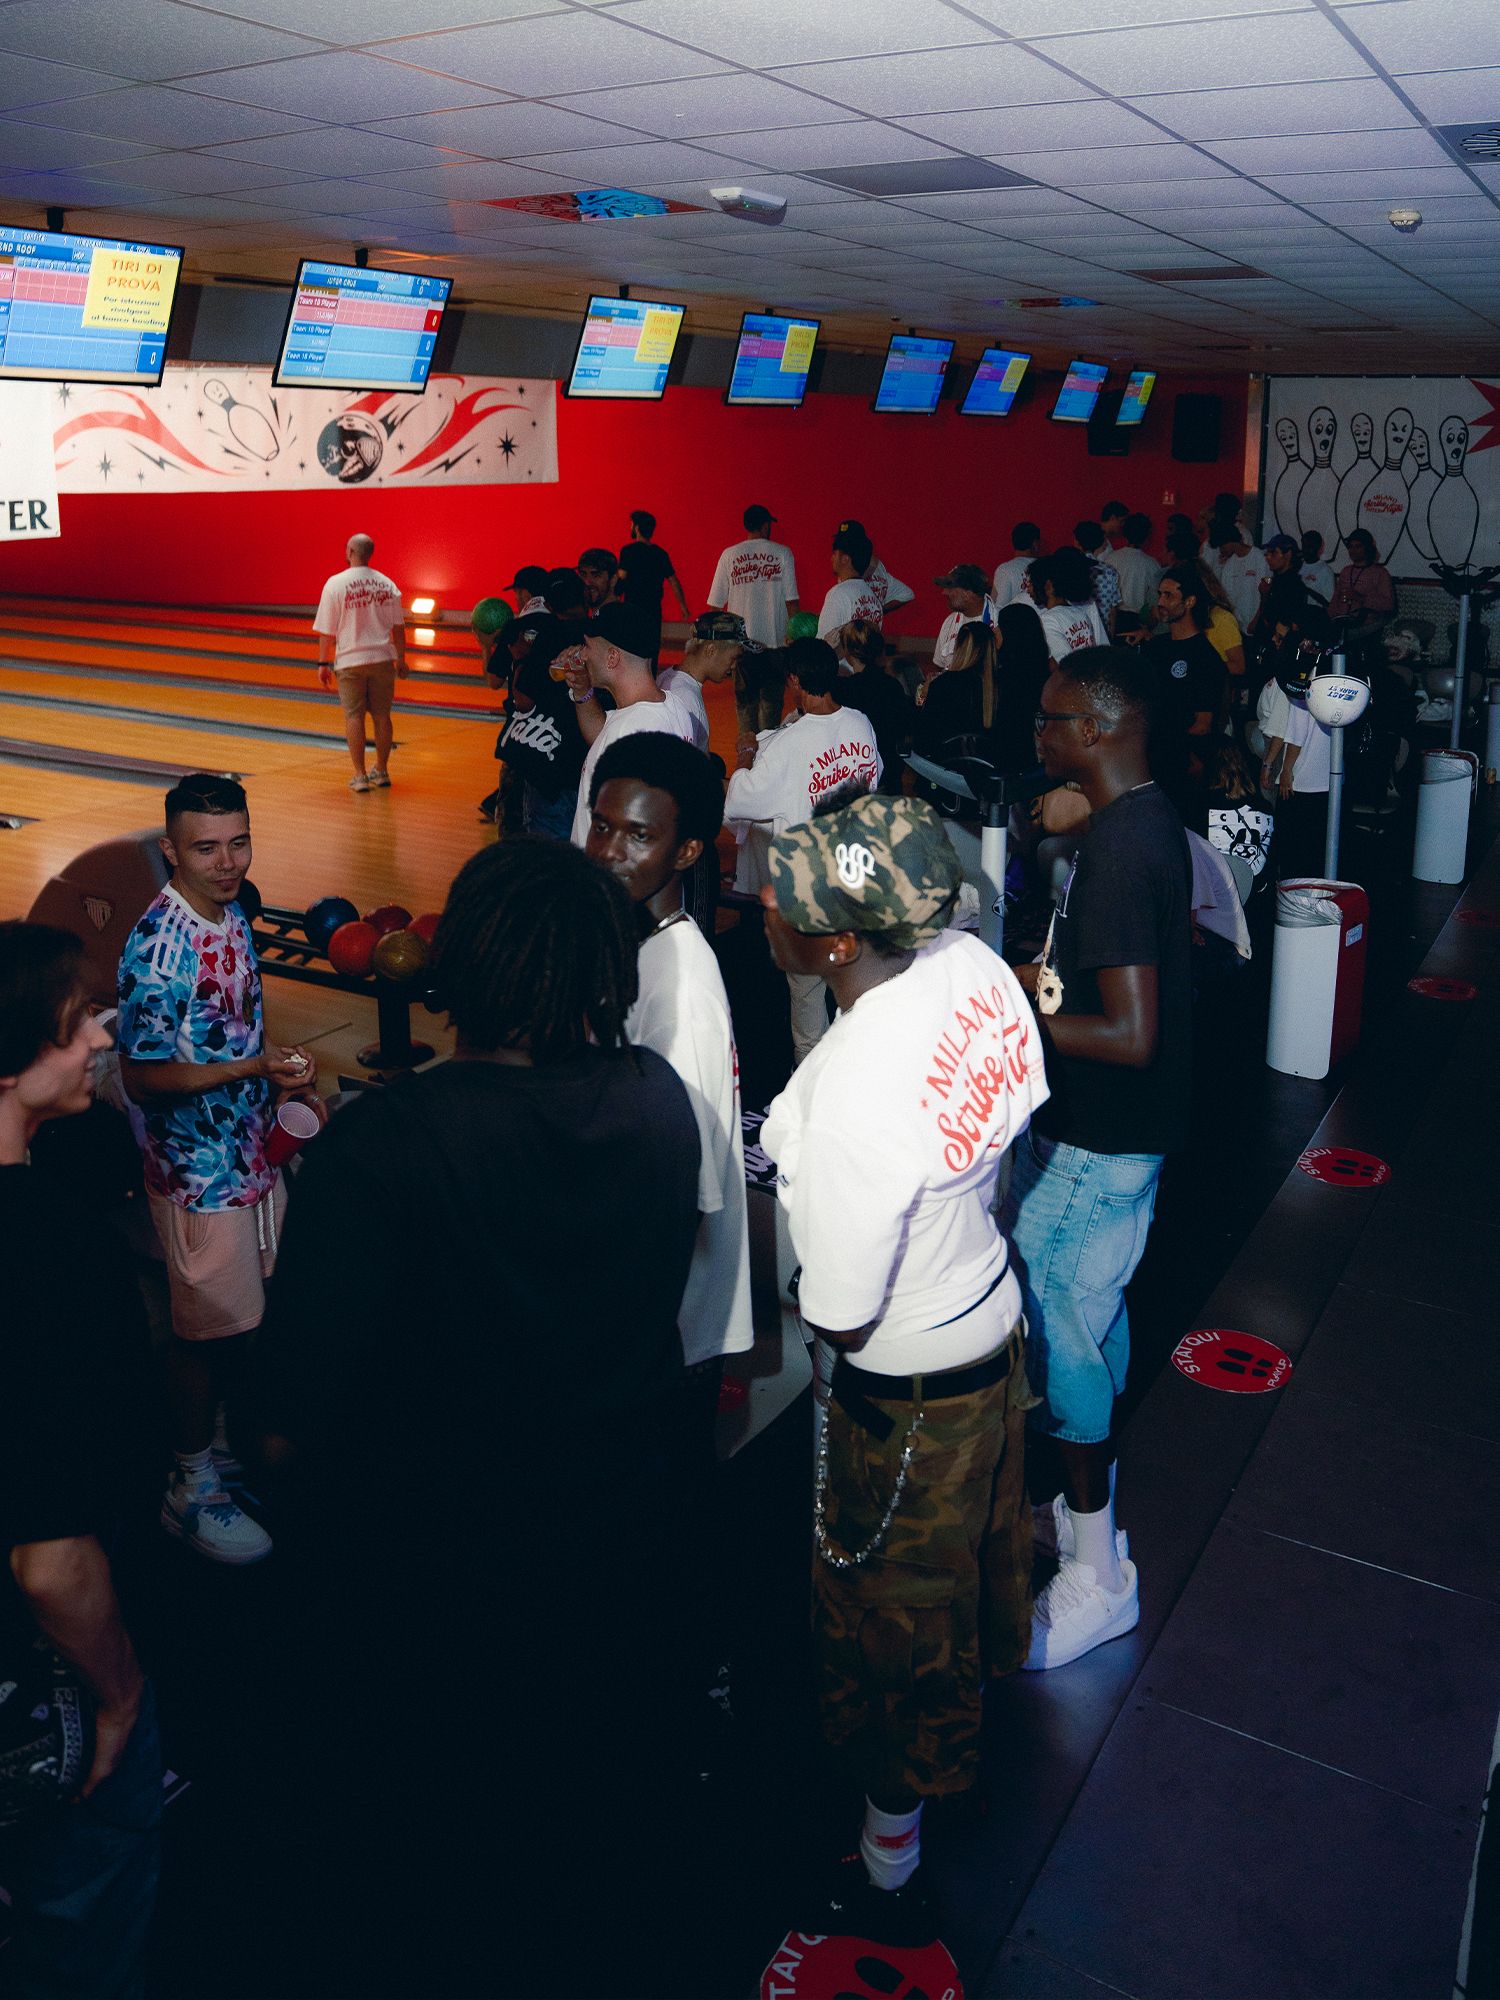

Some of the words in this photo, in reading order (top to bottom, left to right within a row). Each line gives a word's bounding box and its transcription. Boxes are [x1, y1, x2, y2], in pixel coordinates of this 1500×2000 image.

[112, 258, 140, 272] TIRI
[145, 262, 162, 275] DI
[107, 276, 160, 291] PROVA
[735, 552, 774, 564] MILANO
[731, 562, 758, 578] Strike
[754, 562, 782, 580] Night
[349, 579, 385, 589] MILANO
[816, 741, 870, 770] MILANO
[808, 762, 851, 795] Strike
[926, 985, 1005, 1100] MILANO
[938, 1056, 1005, 1173] Strike
[1297, 1154, 1320, 1176] STAI
[1185, 1331, 1220, 1347] QUI
[1174, 1345, 1201, 1374] STAI
[768, 1943, 804, 2000] TAI
